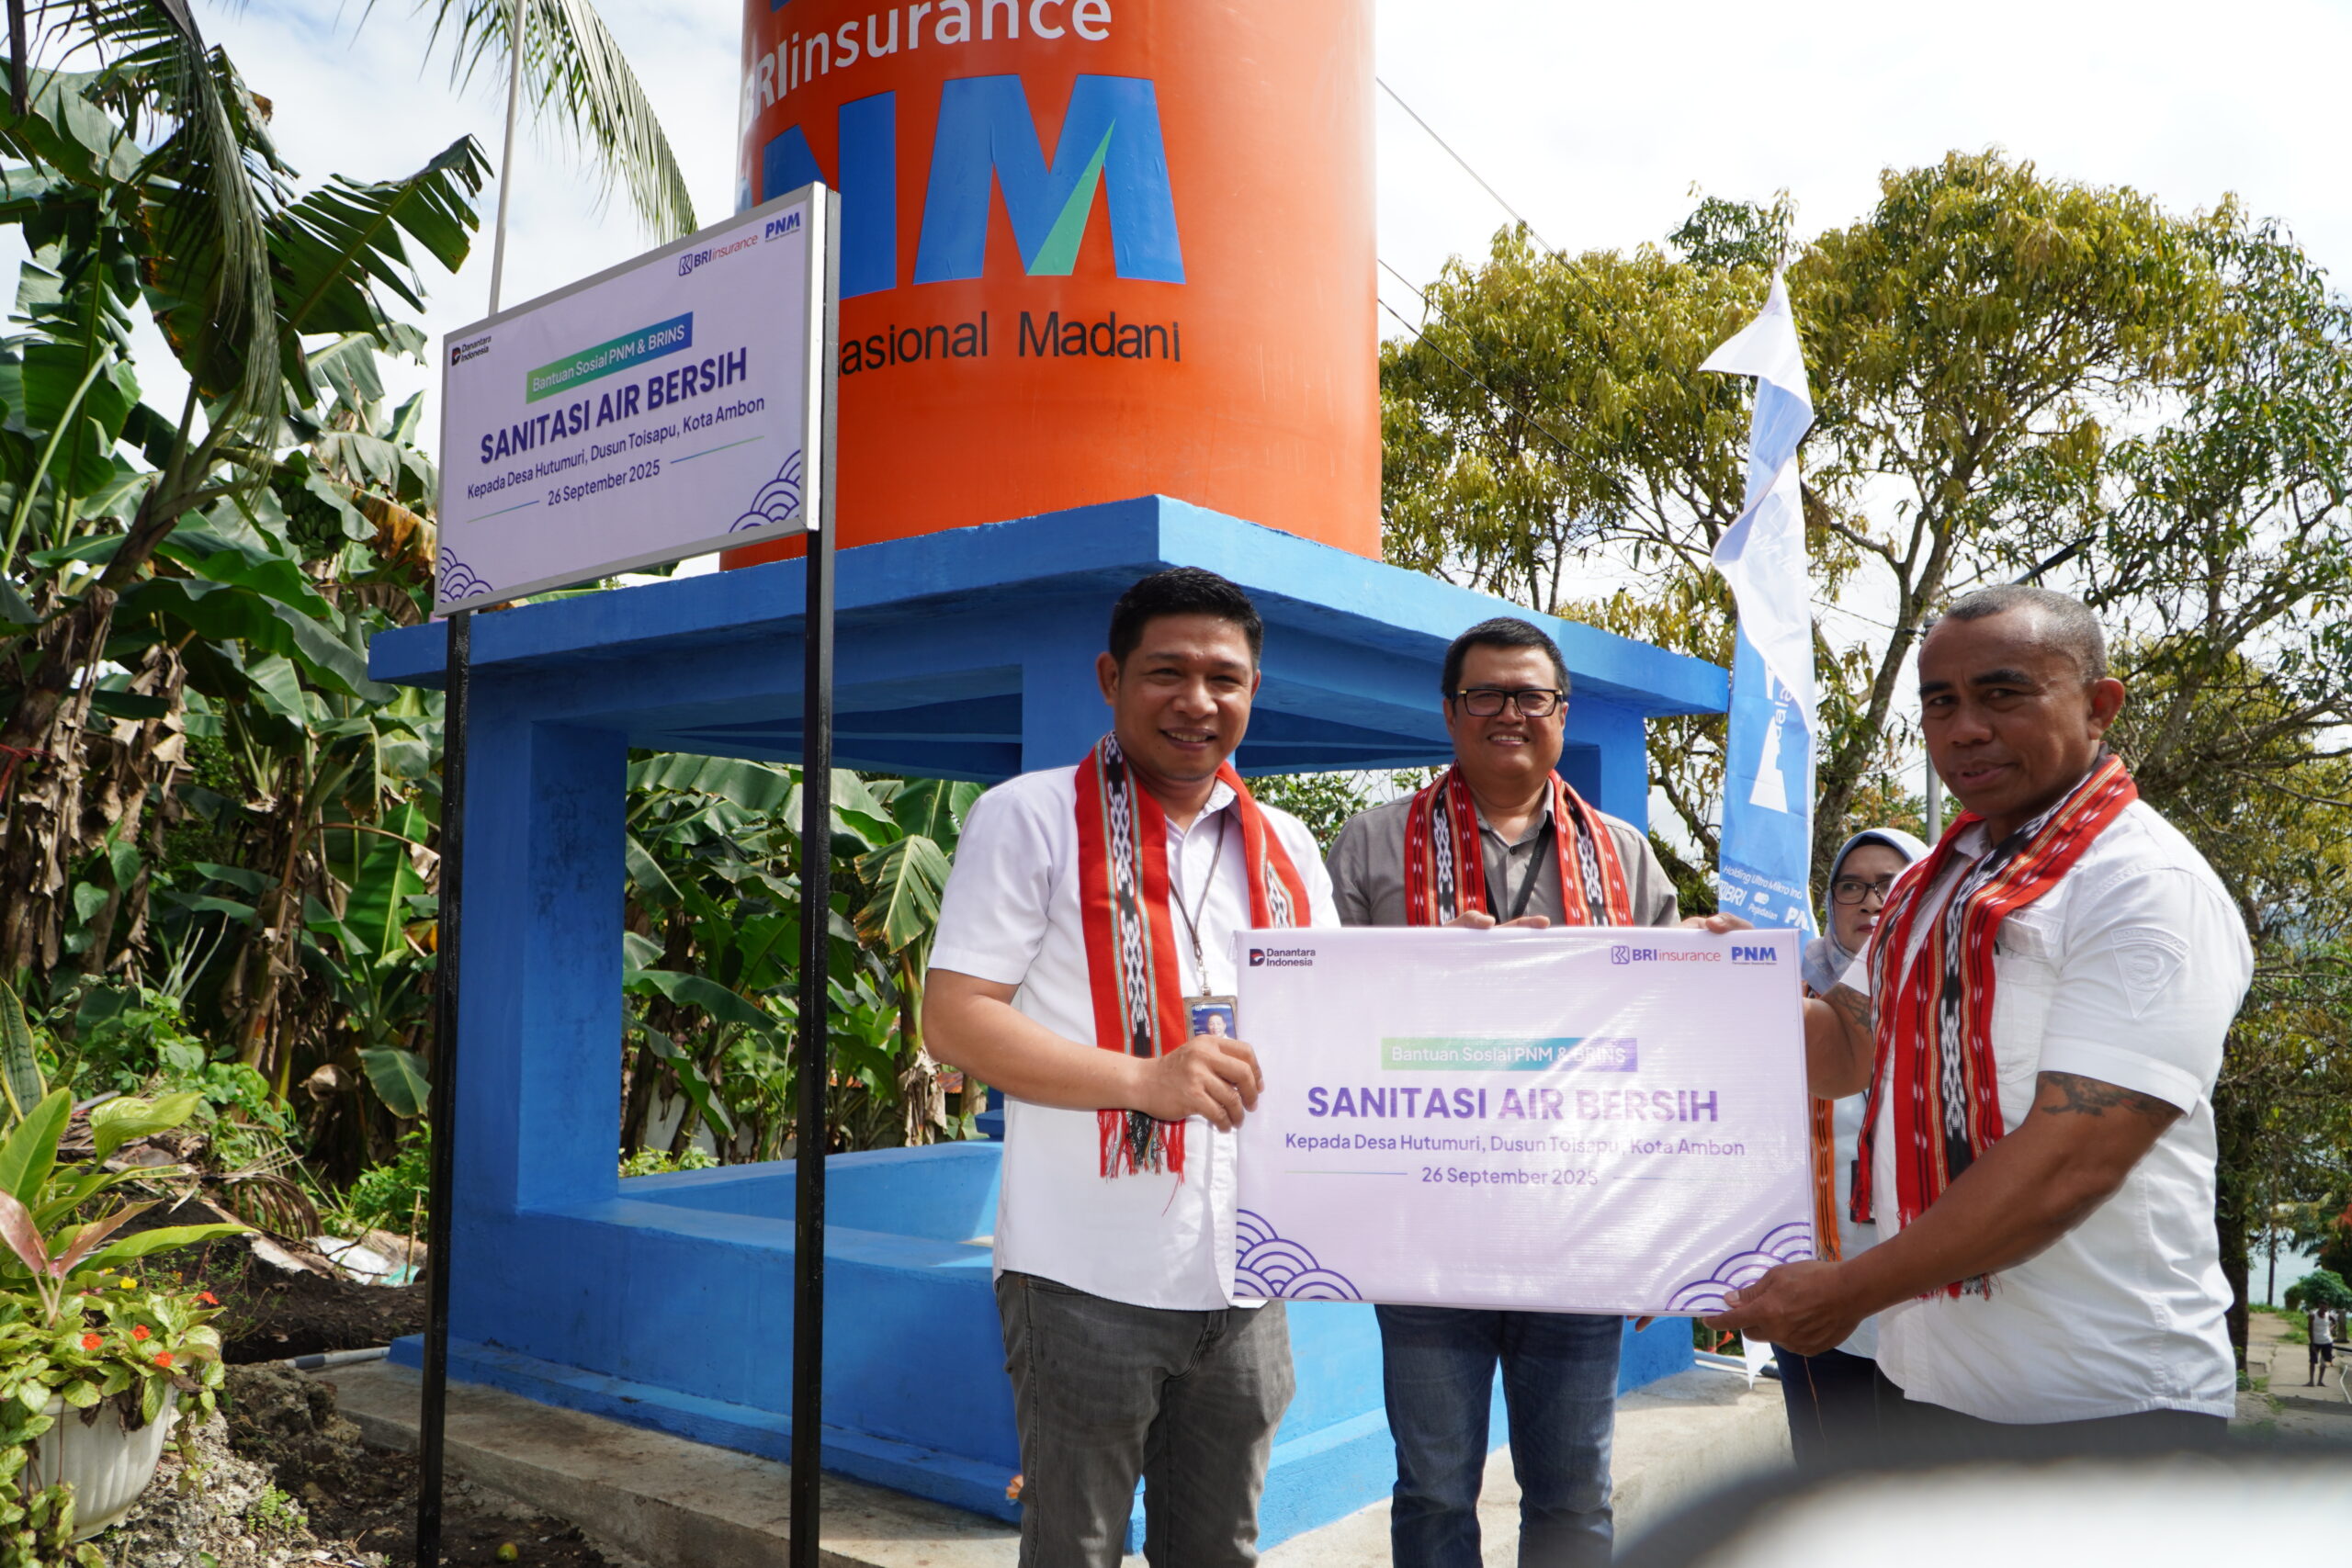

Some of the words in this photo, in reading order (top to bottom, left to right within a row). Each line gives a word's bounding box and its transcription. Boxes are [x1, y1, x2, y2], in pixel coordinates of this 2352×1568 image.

[742, 0, 1112, 133] BRIinsurance
[765, 212, 800, 239] PNM
[694, 235, 759, 268] BRIinsurance
[461, 336, 492, 353] Danantara
[461, 345, 489, 362] Indonesia
[838, 311, 988, 378] asional
[1018, 310, 1181, 362] Madani
[532, 367, 574, 392] Bantuan
[576, 352, 607, 376] Sosial
[609, 343, 635, 365] PNM
[638, 338, 646, 355] &
[649, 324, 684, 350] BRINS
[481, 400, 590, 464] SANITASI
[596, 384, 640, 427] AIR
[648, 346, 747, 411] BERSIH
[468, 476, 505, 500] Kepada
[507, 468, 533, 487] Desa
[536, 449, 588, 479] Hutumuri,
[592, 440, 627, 461] Dusun
[628, 424, 680, 450] Toisapu,
[683, 412, 713, 434] Kota
[716, 398, 764, 423] Ambon
[548, 489, 561, 506] 26
[563, 473, 628, 503] September
[629, 459, 661, 483] 2025
[1723, 865, 1751, 885] Holding
[1751, 874, 1769, 887] Ultra
[1767, 880, 1790, 896] Mikro
[1725, 885, 1747, 907] BRI
[1266, 948, 1316, 957] Danantara
[1266, 958, 1313, 967] Indonesia
[1633, 949, 1721, 962] BRIinsurance
[1731, 947, 1777, 961] PNM
[1392, 1046, 1458, 1061] Bantuan
[1462, 1046, 1511, 1062] Sosial
[1516, 1047, 1553, 1062] PNM
[1557, 1047, 1567, 1062] &
[1576, 1047, 1626, 1064] BRINS
[1307, 1087, 1487, 1119] SANITASI
[1498, 1089, 1565, 1120] AIR
[1576, 1089, 1718, 1122] BERSIH
[1286, 1133, 1351, 1152] Kepada
[1354, 1134, 1396, 1150] Desa
[1400, 1134, 1486, 1154] Hutumuri,
[1491, 1135, 1545, 1152] Dusun
[1550, 1136, 1625, 1156] Toisapu,
[1631, 1139, 1673, 1155] Kota
[1678, 1138, 1745, 1156] Ambon
[1421, 1167, 1442, 1182] 26
[1447, 1168, 1547, 1187] September
[1552, 1169, 1599, 1185] 2025
